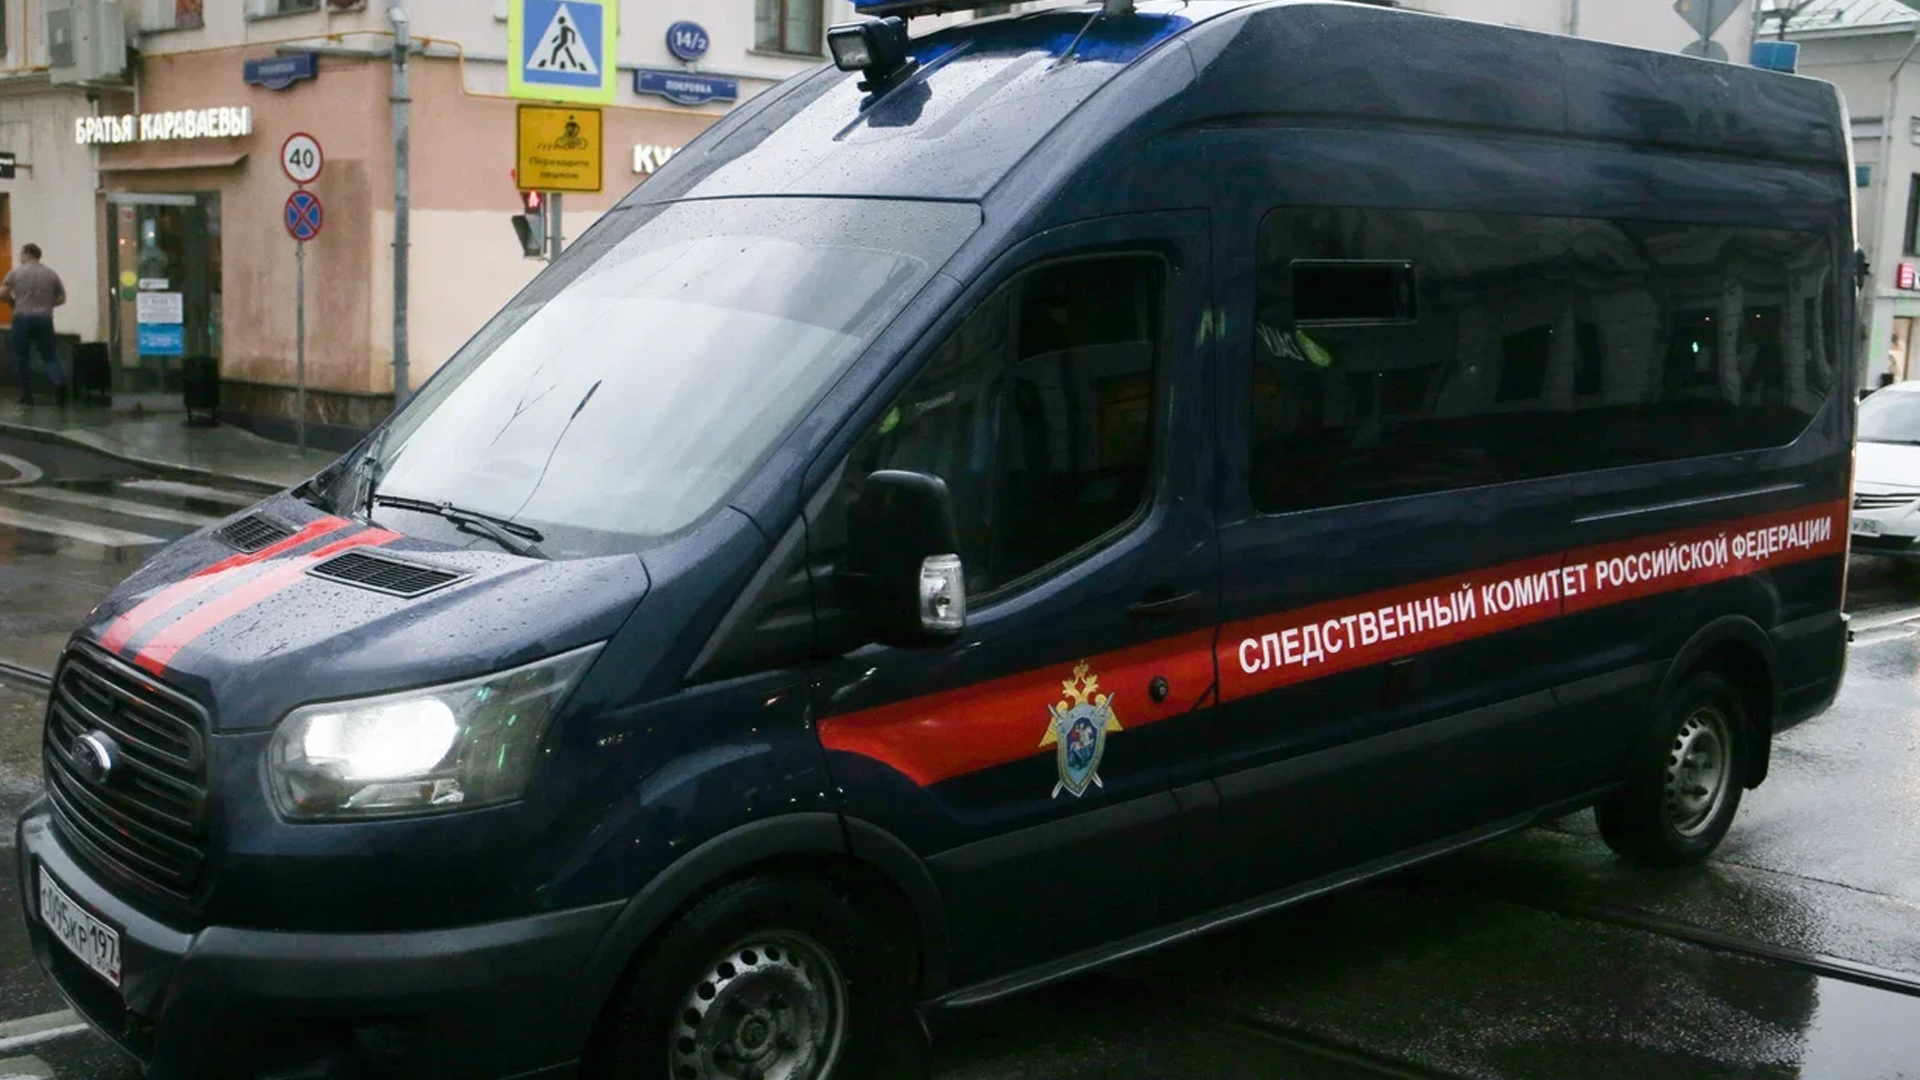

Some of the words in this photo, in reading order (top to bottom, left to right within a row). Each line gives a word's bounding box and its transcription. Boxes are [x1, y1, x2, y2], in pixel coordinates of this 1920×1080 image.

[676, 31, 706, 50] 14/2
[75, 115, 135, 145] БРАТЬЯ
[140, 106, 251, 141] КАРАВАЕВЫ
[289, 148, 314, 169] 40
[633, 144, 681, 173] КУ
[1238, 582, 1477, 675] СЛЕДСТВЕННЫЙ
[1482, 563, 1589, 616] КОМИТЕТ
[1595, 532, 1729, 590] РОССИЙСКОЙ
[1731, 515, 1832, 561] ФЕДЕРАЦИИ
[90, 924, 116, 963] 197
